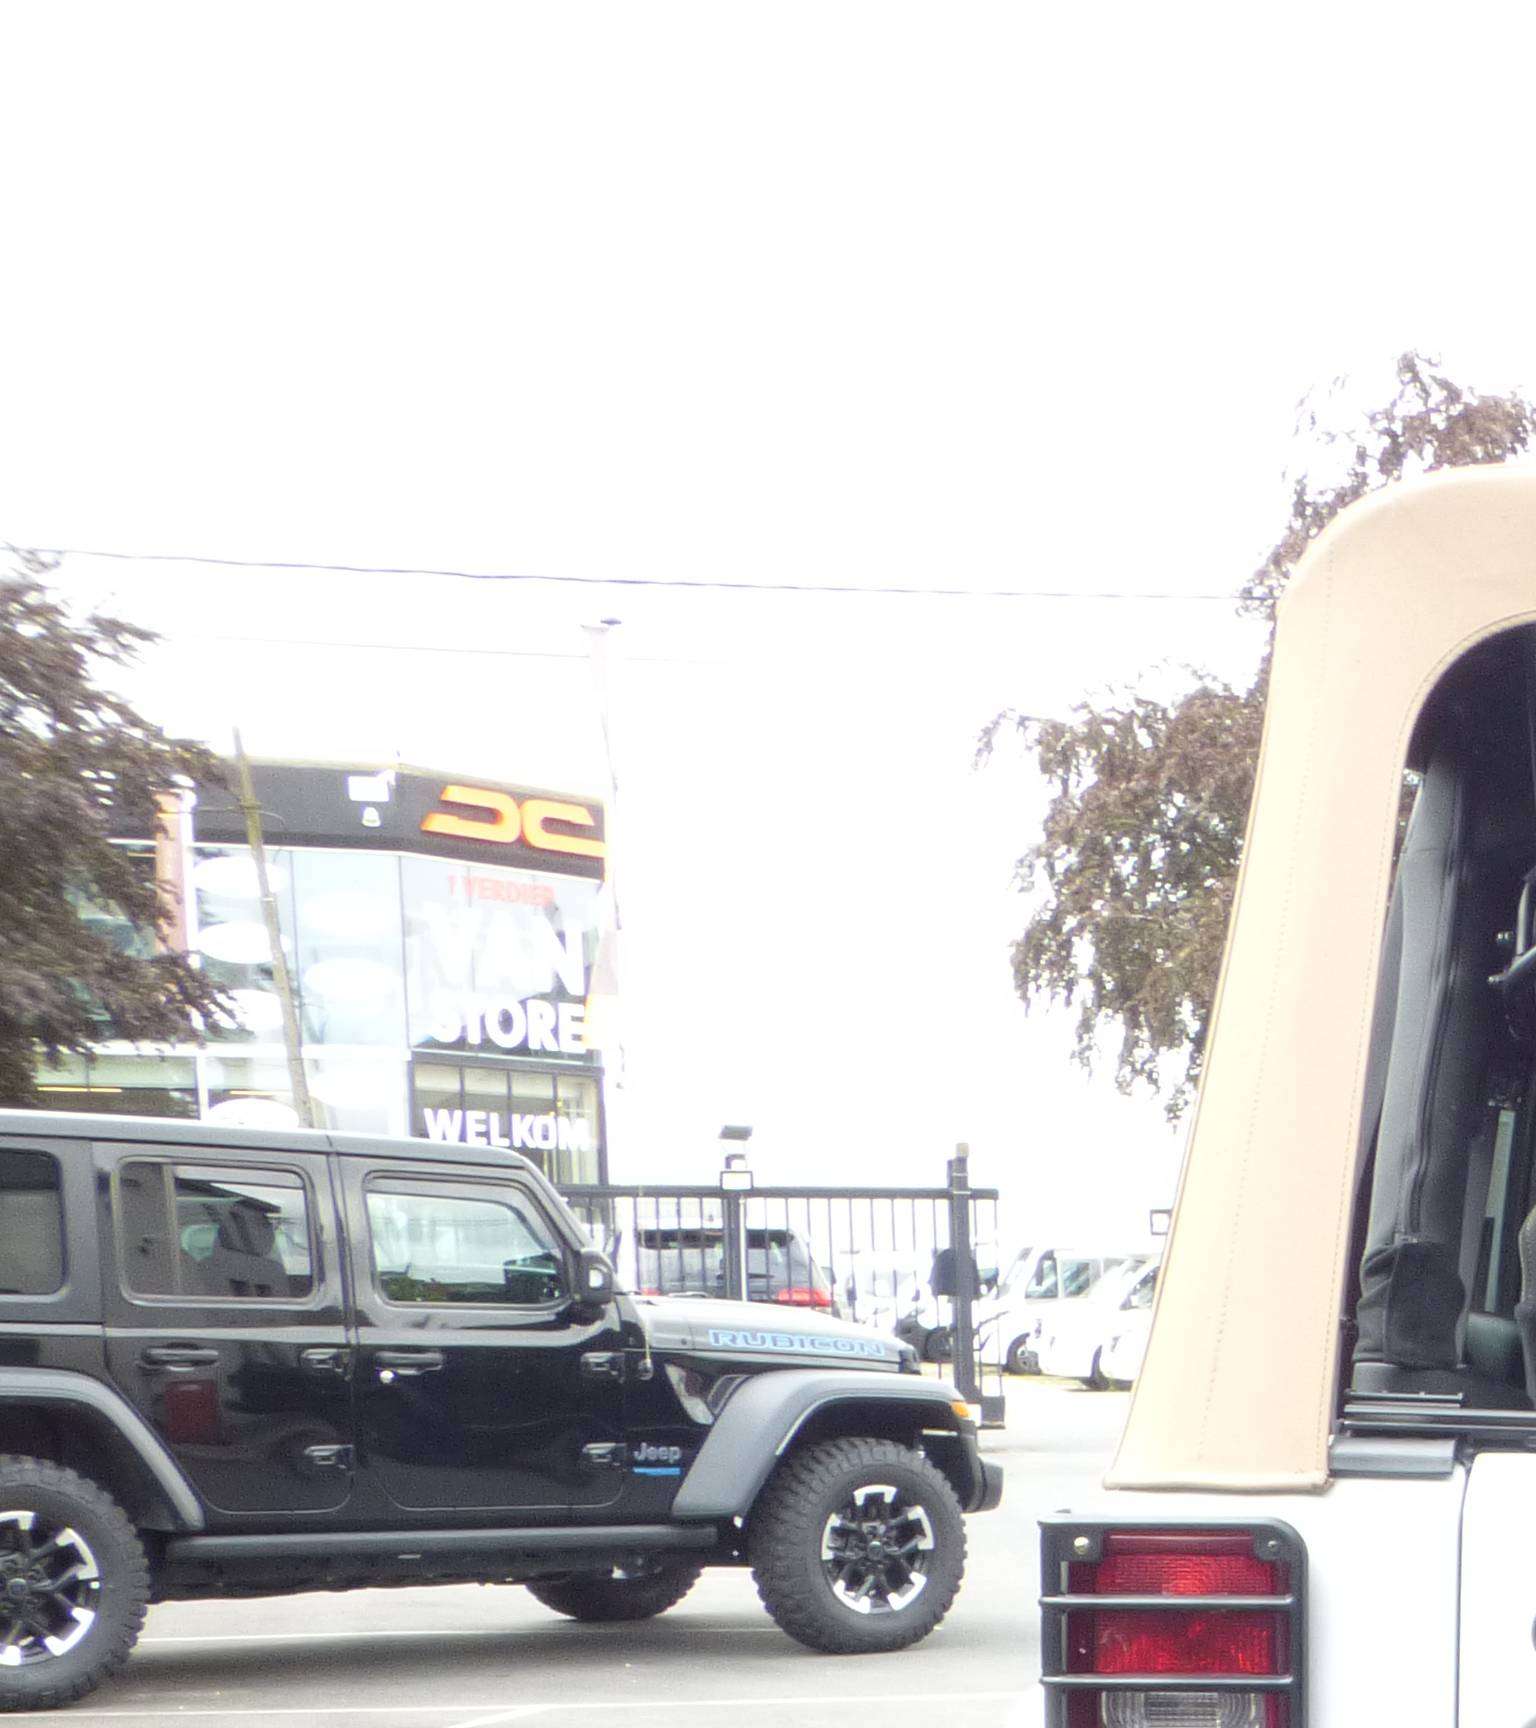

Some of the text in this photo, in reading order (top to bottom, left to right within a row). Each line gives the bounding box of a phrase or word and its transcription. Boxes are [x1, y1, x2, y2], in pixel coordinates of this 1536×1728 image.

[432, 990, 587, 1053] STORE
[424, 1108, 592, 1150] WELKOM
[709, 1329, 885, 1356] RUBICON
[634, 1443, 681, 1462] Jeep
